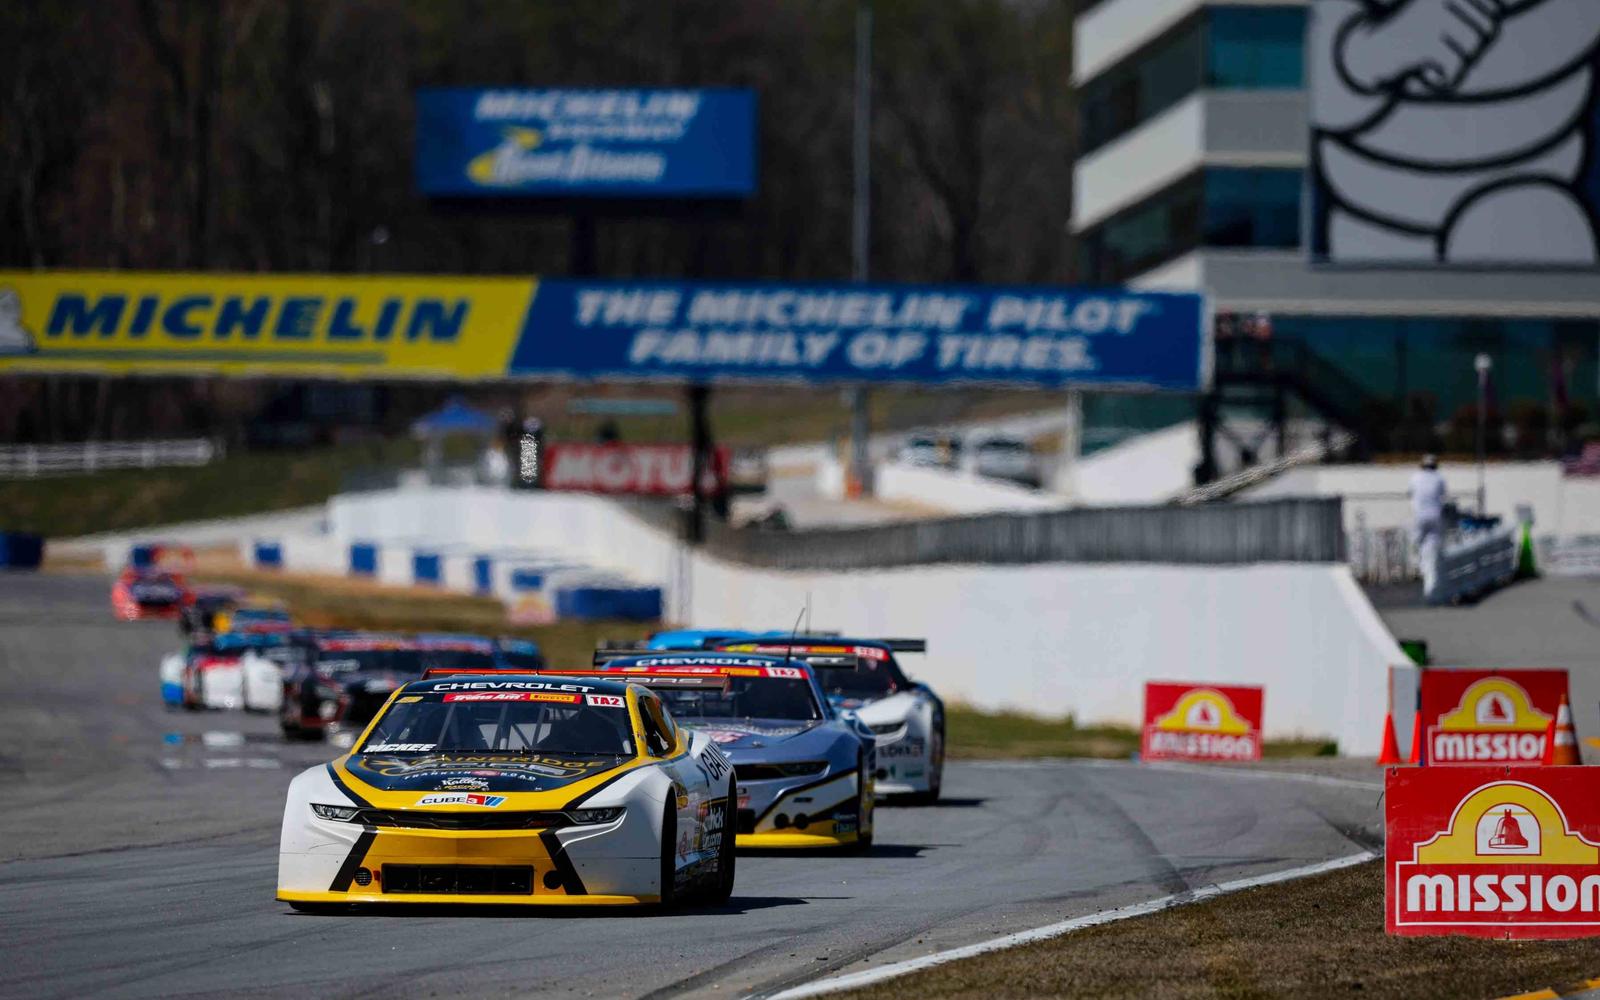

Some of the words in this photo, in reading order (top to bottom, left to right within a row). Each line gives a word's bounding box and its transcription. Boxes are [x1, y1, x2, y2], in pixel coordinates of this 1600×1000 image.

[576, 288, 676, 325] THE
[688, 290, 966, 329] MICHELIN
[988, 296, 1146, 333] PILOT
[47, 293, 471, 342] MICHELIN
[630, 329, 836, 367] FAMILY
[849, 333, 922, 369] OF
[636, 656, 777, 668] CHEVROLET
[433, 682, 595, 693] CHEVROLET
[591, 696, 621, 706] TA2
[404, 770, 472, 780] FRANKLIN
[501, 772, 537, 782] ROAD
